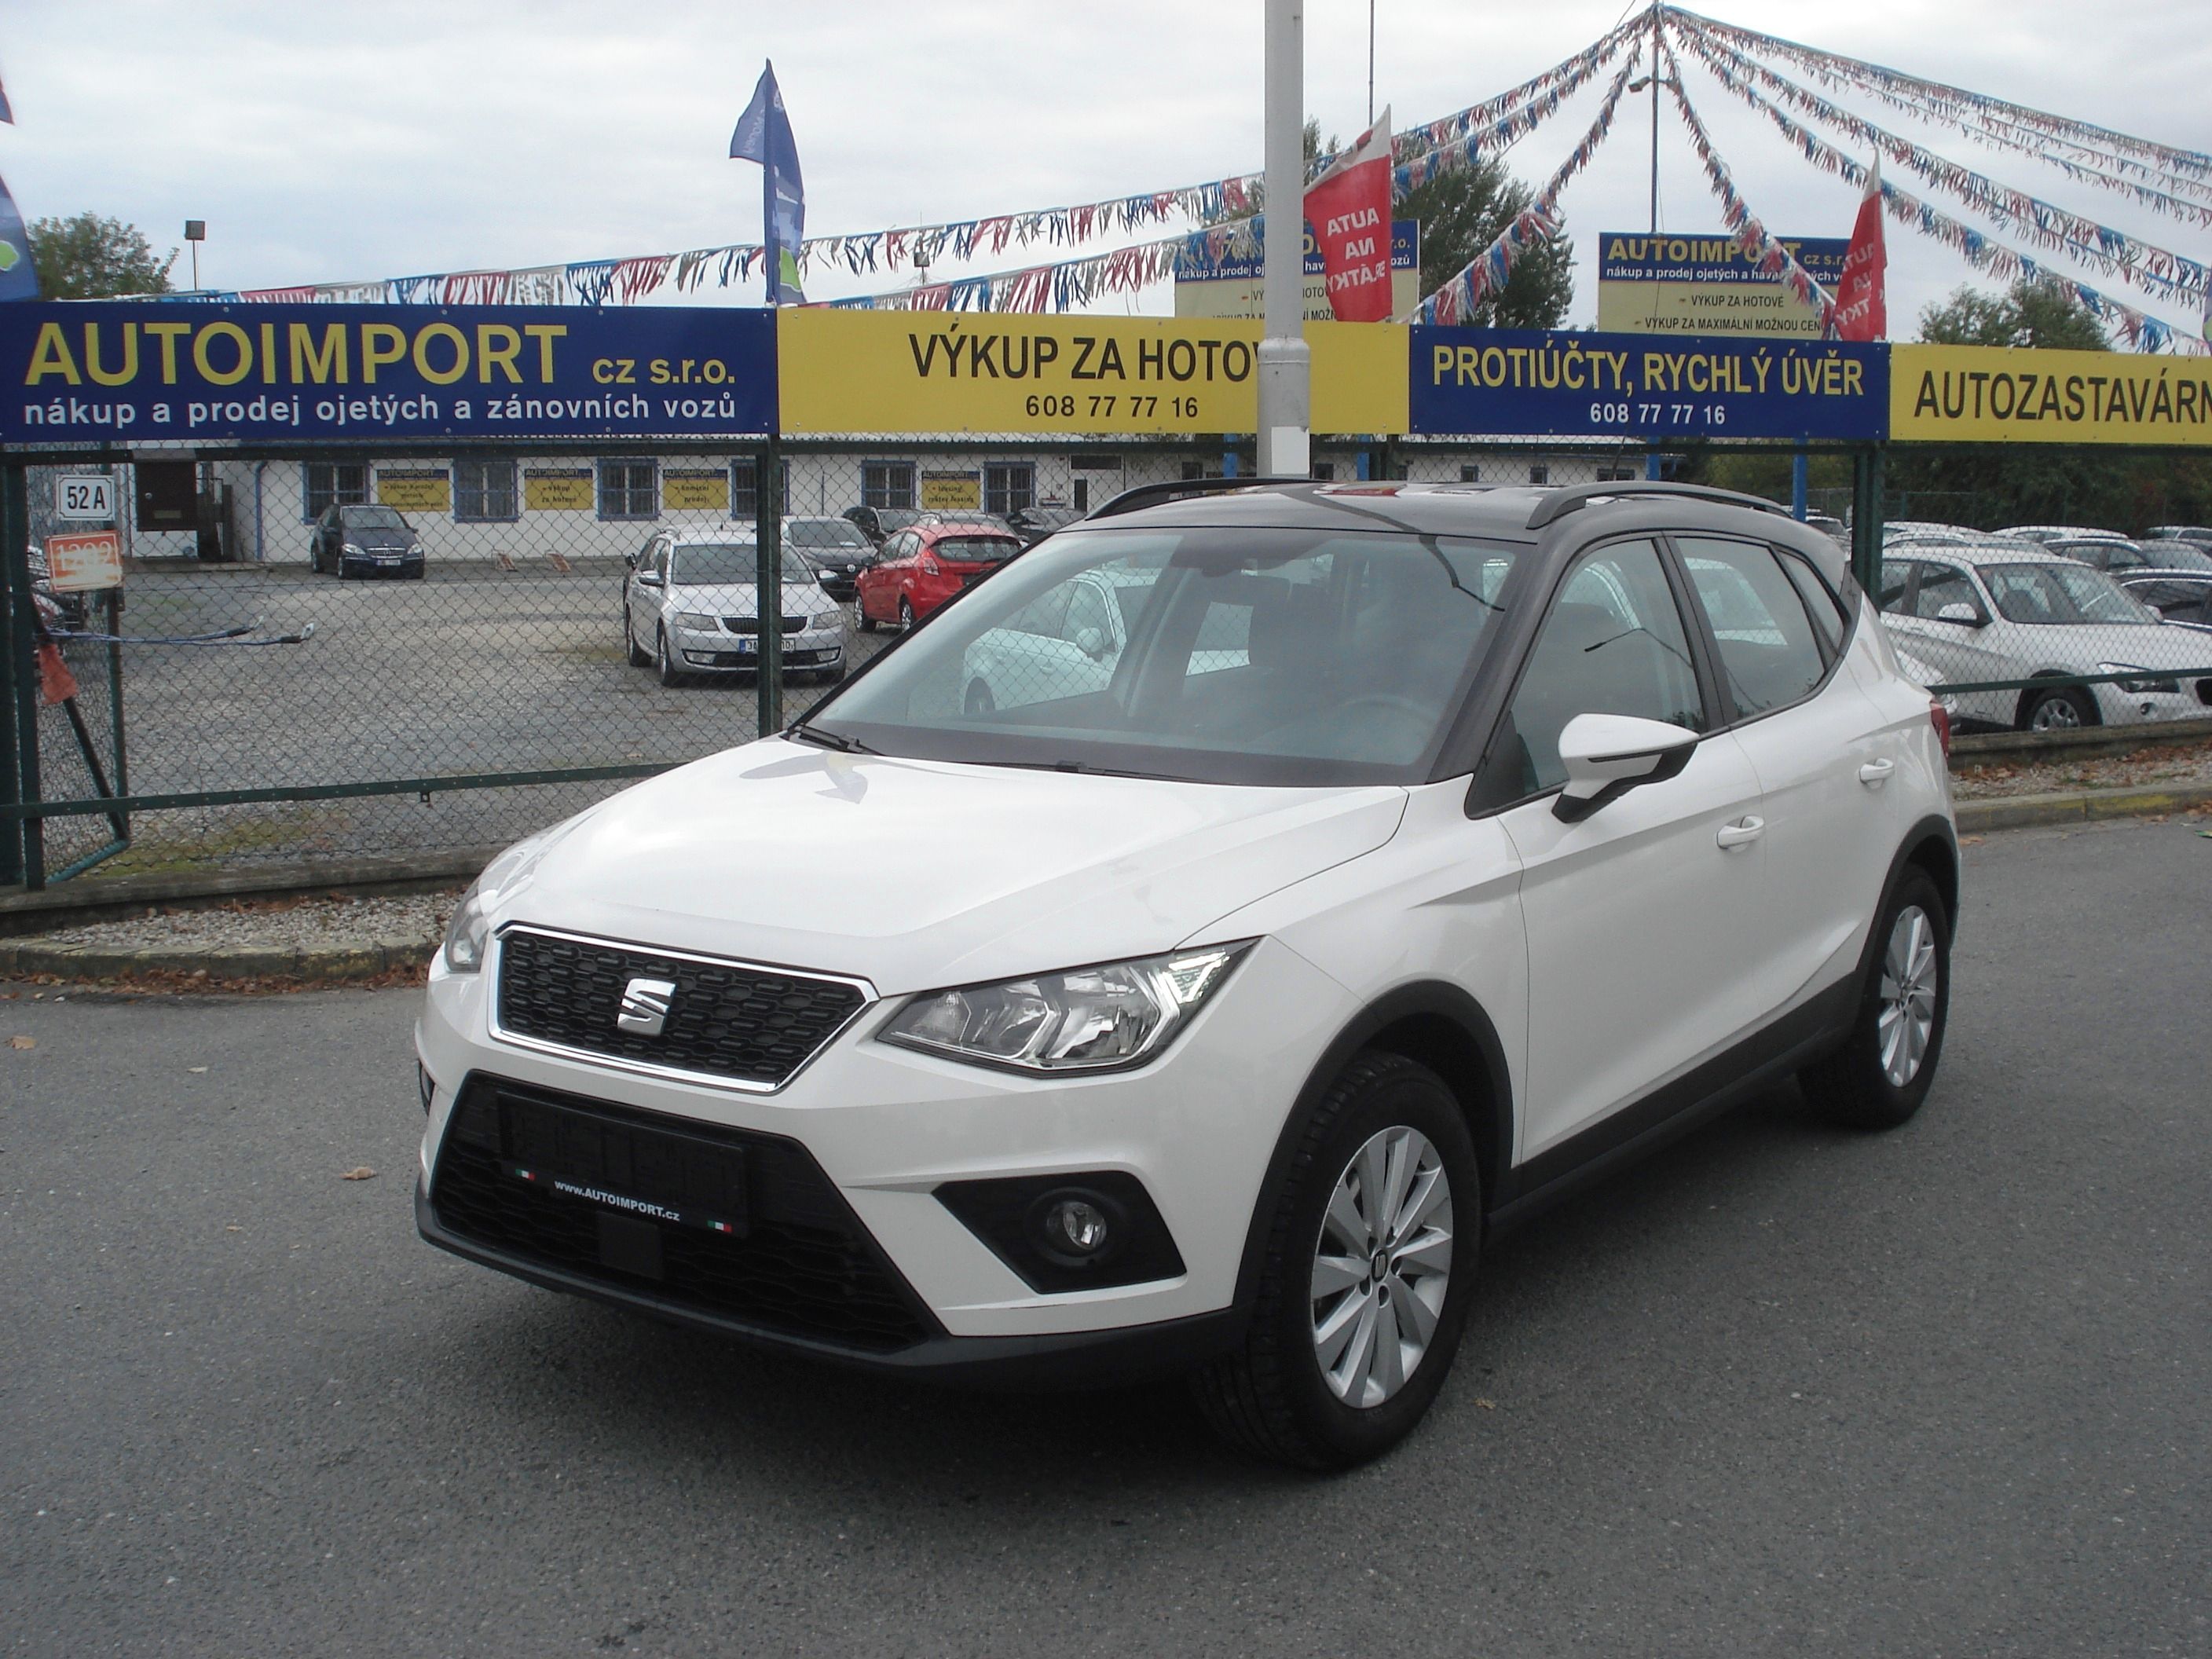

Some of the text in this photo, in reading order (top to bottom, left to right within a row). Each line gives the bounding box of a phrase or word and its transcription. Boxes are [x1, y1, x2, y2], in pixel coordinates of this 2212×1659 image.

[1607, 238, 1801, 262] AUTOIMPOT
[1804, 254, 1822, 265] cz
[1221, 265, 1251, 278] prodej
[1606, 267, 1643, 280] nákup
[1657, 267, 1693, 280] prodej
[1696, 267, 1738, 281] ojetých
[1741, 270, 1749, 279] a
[1691, 293, 1784, 307] VÝKUP ZA HOTOVÉ
[1645, 315, 1823, 331] VÝKUP ZA MAXIMÁLNÍ MOŽNOU CEN
[24, 321, 735, 386] AUTOIMPORT cz s.r.o.
[909, 323, 1258, 382] VÝKUP ZA HOTO
[1434, 339, 1864, 397] PROTIÚČTY, RYCHLÝ ÚVĚR
[24, 391, 736, 429] nákup a prodej ojetých a zánovních vozů
[1026, 394, 1199, 418] 608 77 77 16
[1590, 402, 1726, 425] 608 77 77 16
[68, 486, 105, 510] 52 A
[555, 1181, 680, 1221] www.AUTOIMPORT.cz
